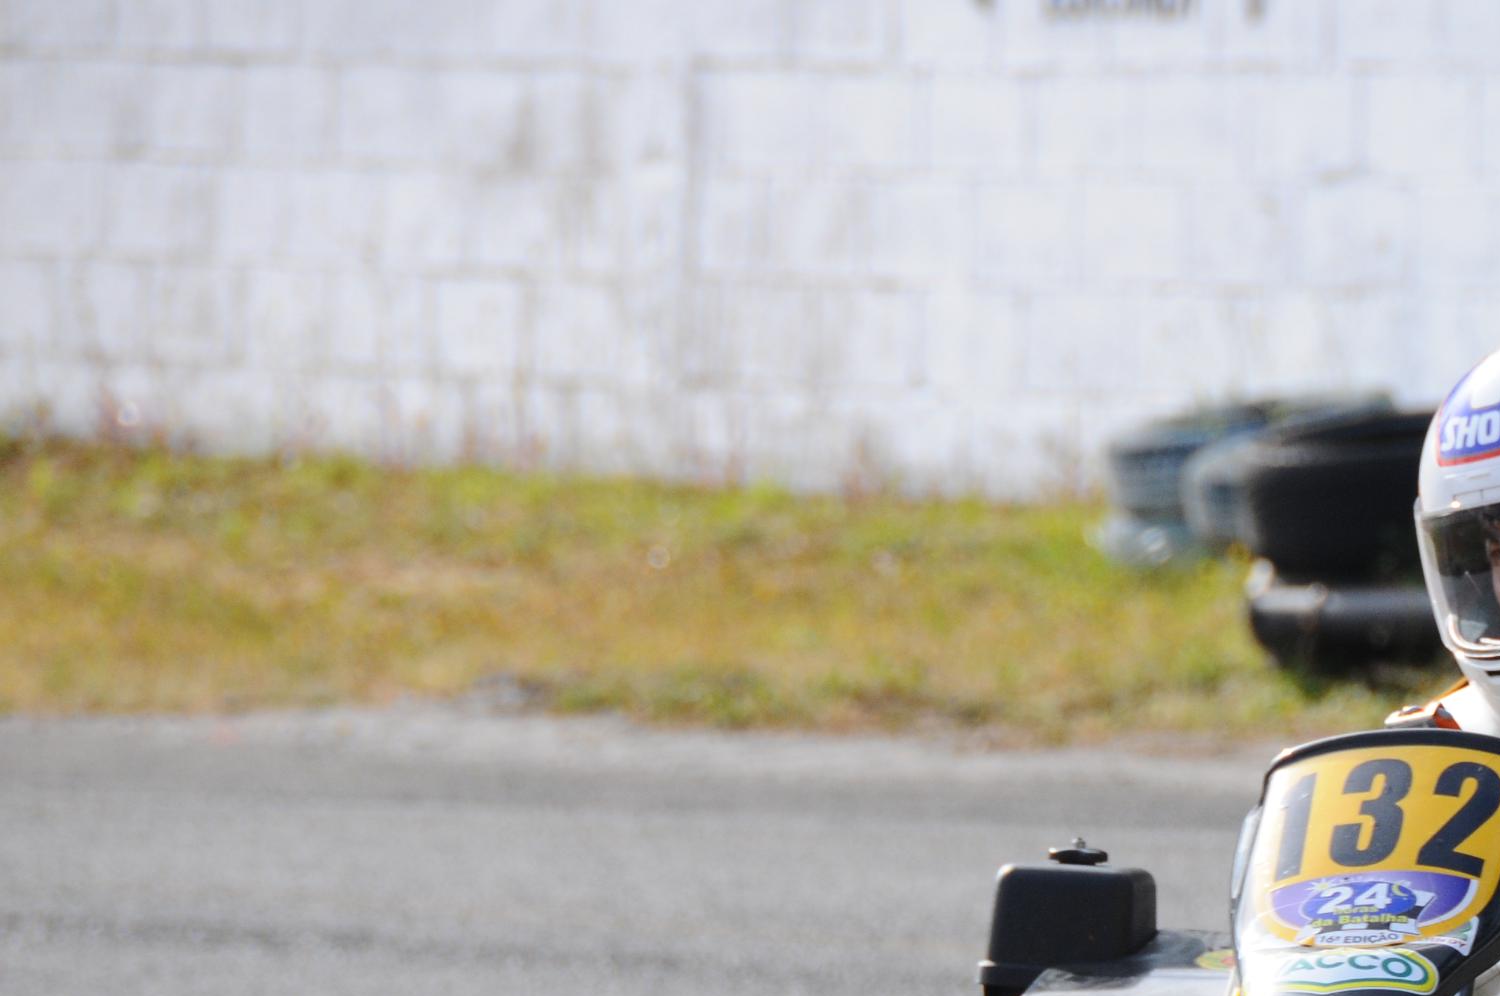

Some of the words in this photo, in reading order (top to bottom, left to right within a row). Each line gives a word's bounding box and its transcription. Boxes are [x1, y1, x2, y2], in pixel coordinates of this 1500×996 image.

[1317, 883, 1392, 914] 24
[1338, 912, 1409, 924] Batalha
[1343, 931, 1400, 945] EDIÇÃO
